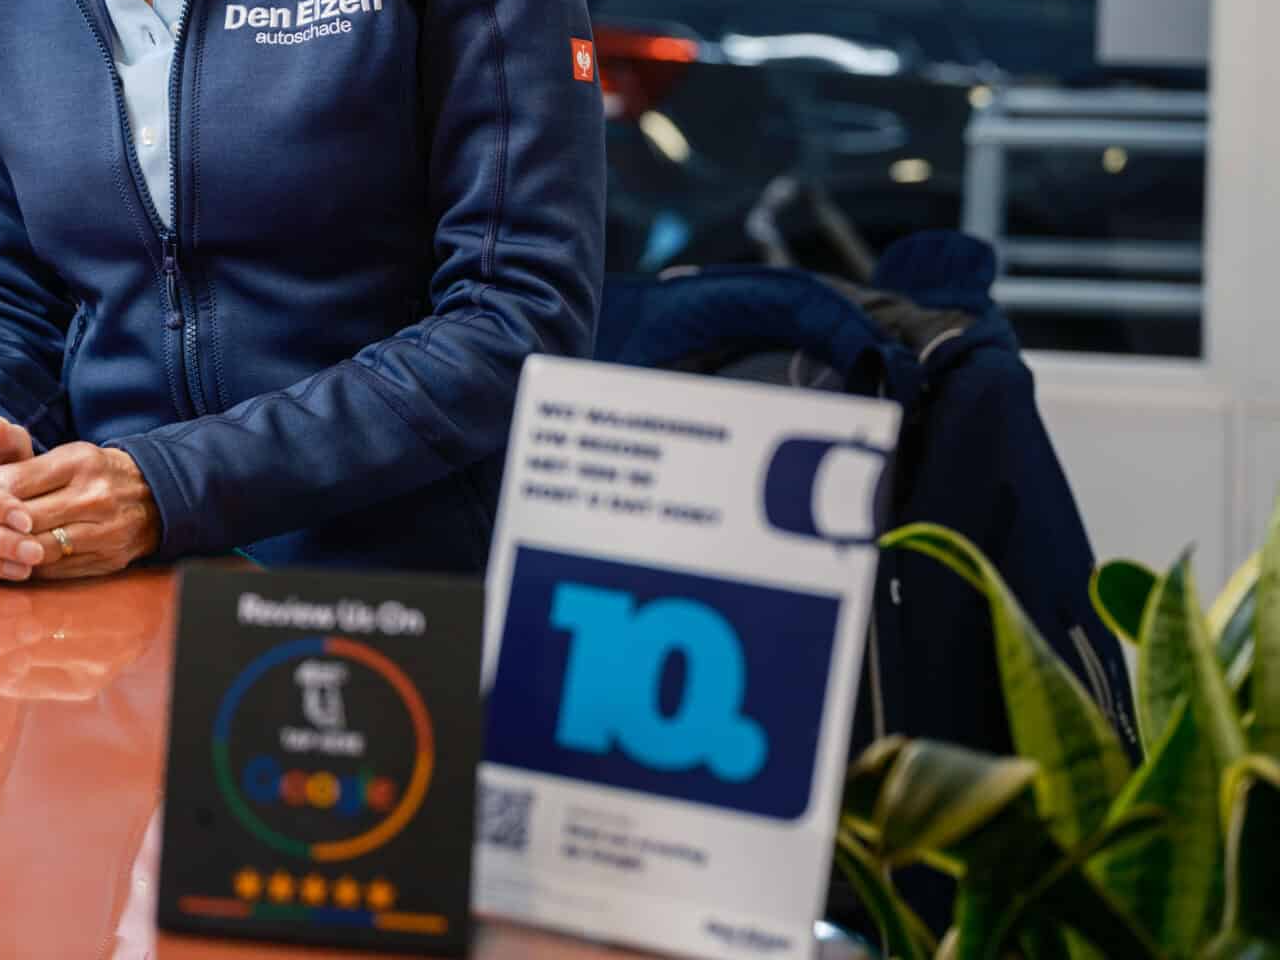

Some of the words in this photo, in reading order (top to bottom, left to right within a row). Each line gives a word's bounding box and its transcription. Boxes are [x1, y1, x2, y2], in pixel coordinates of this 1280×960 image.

[224, 4, 291, 30] Den
[255, 17, 353, 45] autoschade
[237, 591, 335, 629] Review
[336, 598, 376, 632] Us
[376, 600, 426, 635] On
[244, 755, 397, 816] Google
